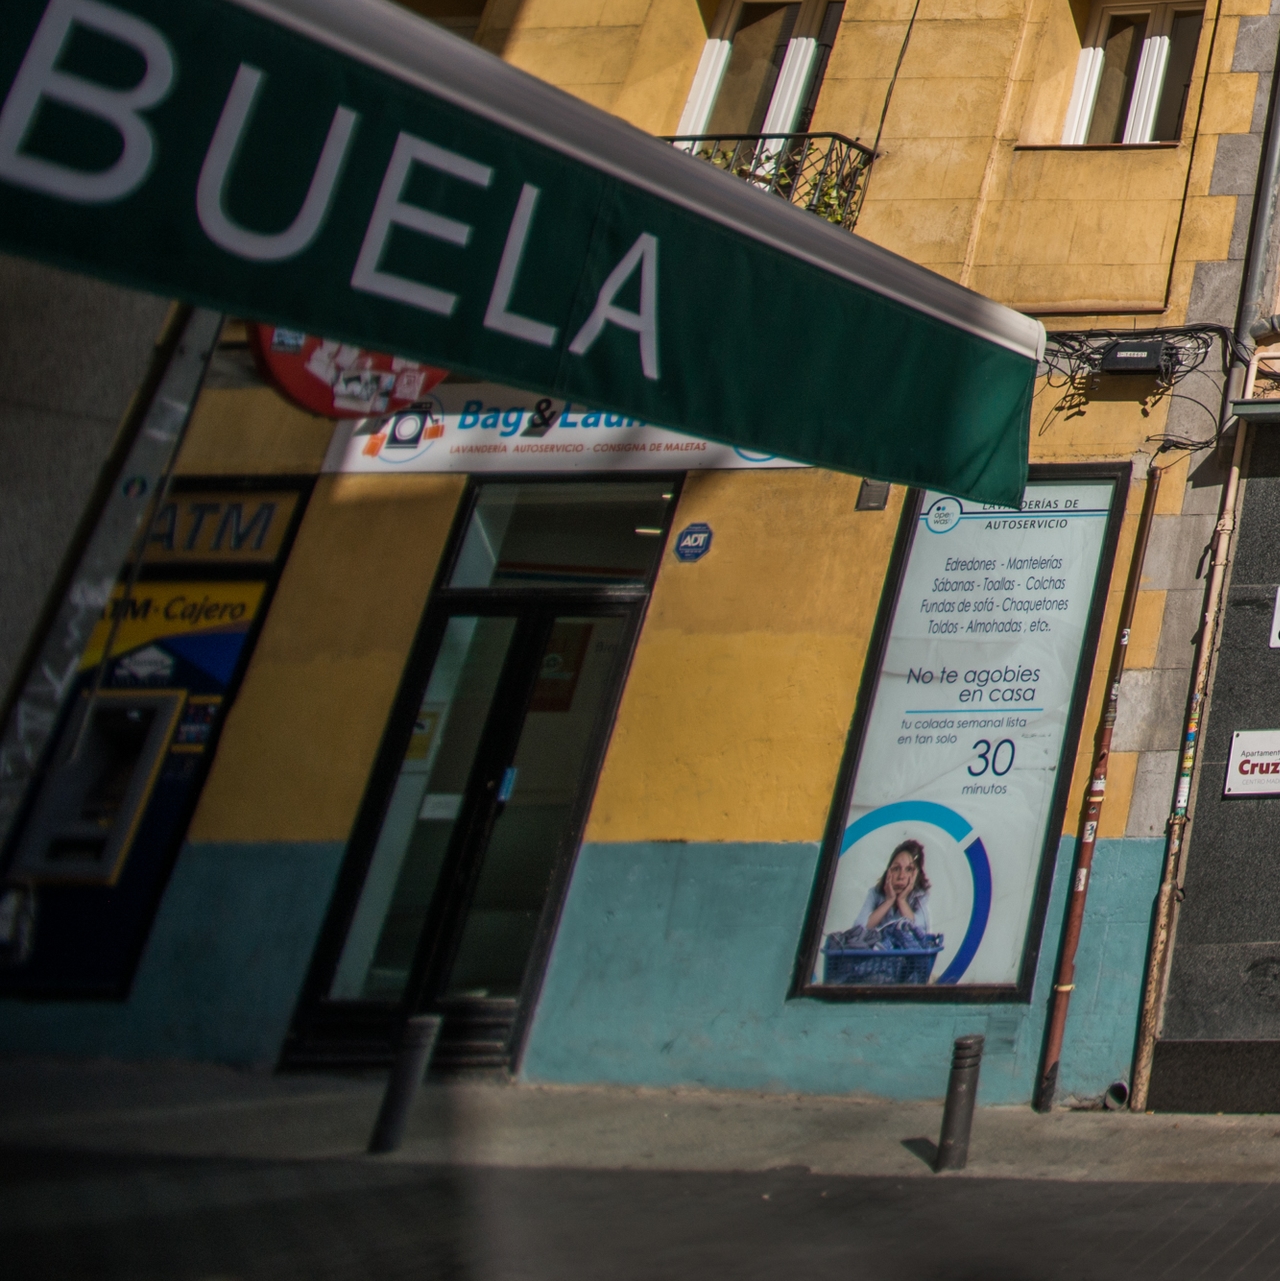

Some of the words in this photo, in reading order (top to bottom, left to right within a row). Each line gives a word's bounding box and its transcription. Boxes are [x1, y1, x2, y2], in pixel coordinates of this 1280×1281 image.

[450, 443, 507, 454] LAVANDERÍA
[513, 443, 584, 454] AUTOSERVICIO
[593, 443, 648, 453] CONSIGNA
[649, 443, 663, 453] DE
[663, 442, 707, 453] MALETAS
[1064, 499, 1079, 509] DE
[148, 503, 276, 550] ATM
[985, 519, 1068, 530] AUTOSERVICIO
[680, 533, 708, 546] ADT
[945, 557, 996, 572] Edredones
[1006, 554, 1063, 570] Mantelerías
[932, 578, 975, 592] Sábanas
[983, 577, 1015, 591] Toallas
[1026, 576, 1066, 591] Colchas
[164, 595, 246, 625] Cajero
[920, 599, 956, 613] Fundas
[957, 599, 971, 612] de
[973, 597, 994, 612] sofá
[1002, 597, 1069, 614] Chaquetones
[928, 620, 958, 634] Toldos
[965, 619, 1022, 633] Almohadas
[907, 667, 934, 684] No
[940, 667, 958, 684] te
[964, 665, 1041, 687] agobies
[958, 688, 983, 702] en
[989, 687, 1036, 702] casa
[901, 719, 913, 730] tu
[914, 718, 954, 729] colada
[956, 717, 1003, 729] semanal
[1006, 717, 1027, 728] lista
[897, 736, 913, 745] en
[915, 734, 933, 744] tan
[935, 733, 958, 744] solo
[967, 738, 1016, 777] 30
[1238, 759, 1280, 775] Cruz
[962, 783, 1007, 795] minutos
